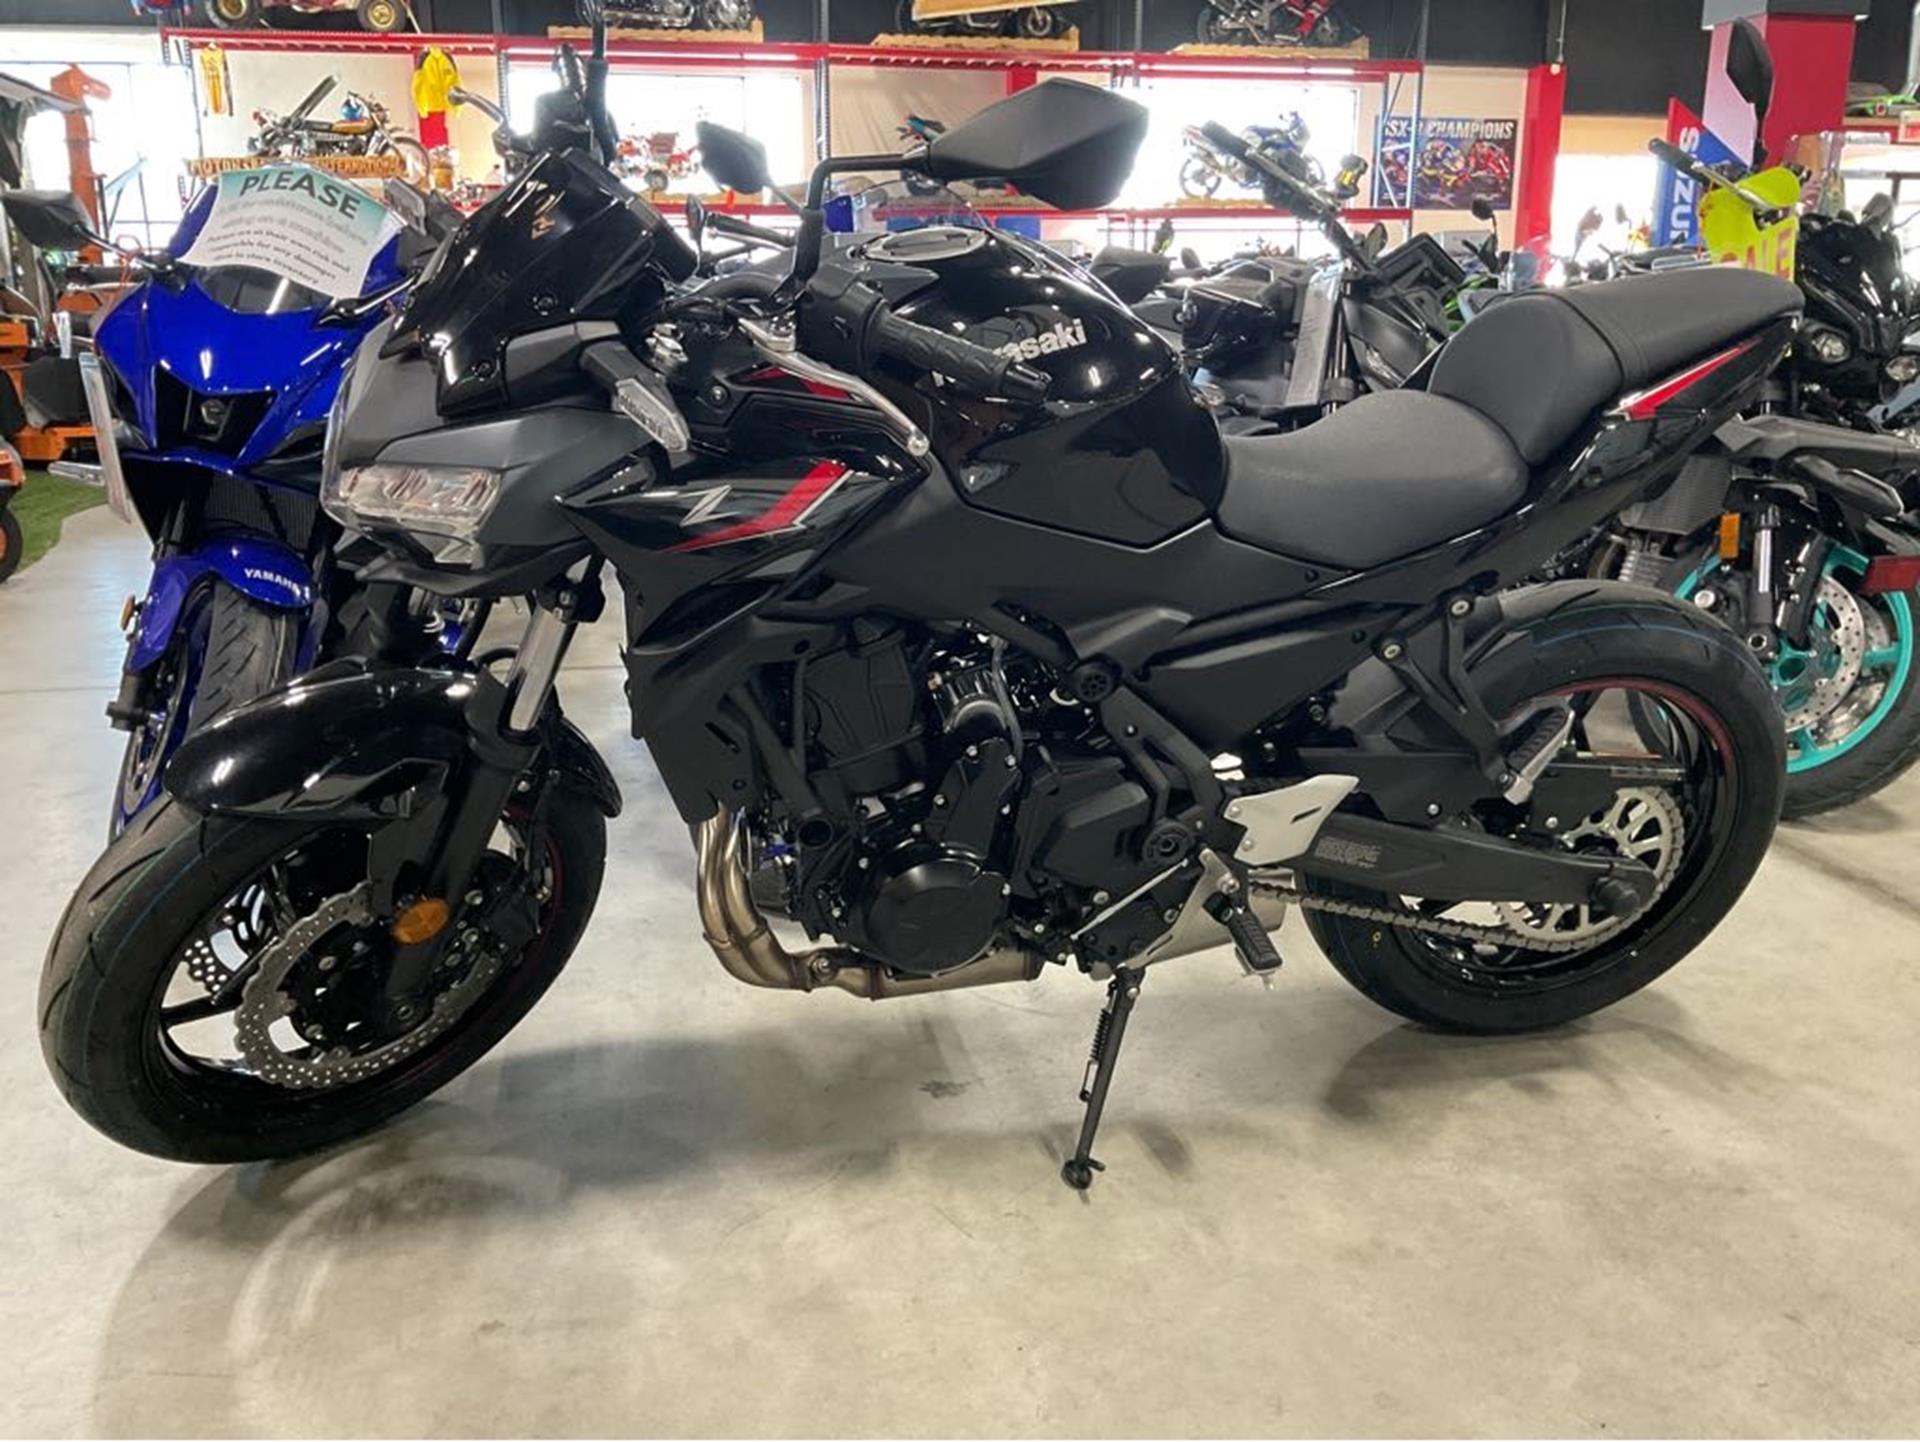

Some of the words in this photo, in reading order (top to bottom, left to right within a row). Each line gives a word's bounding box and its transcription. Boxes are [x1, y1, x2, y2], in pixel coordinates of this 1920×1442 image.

[1427, 121, 1516, 139] CHAMPIONS
[239, 170, 360, 220] PLEASE
[243, 567, 301, 598] YAMAHA
